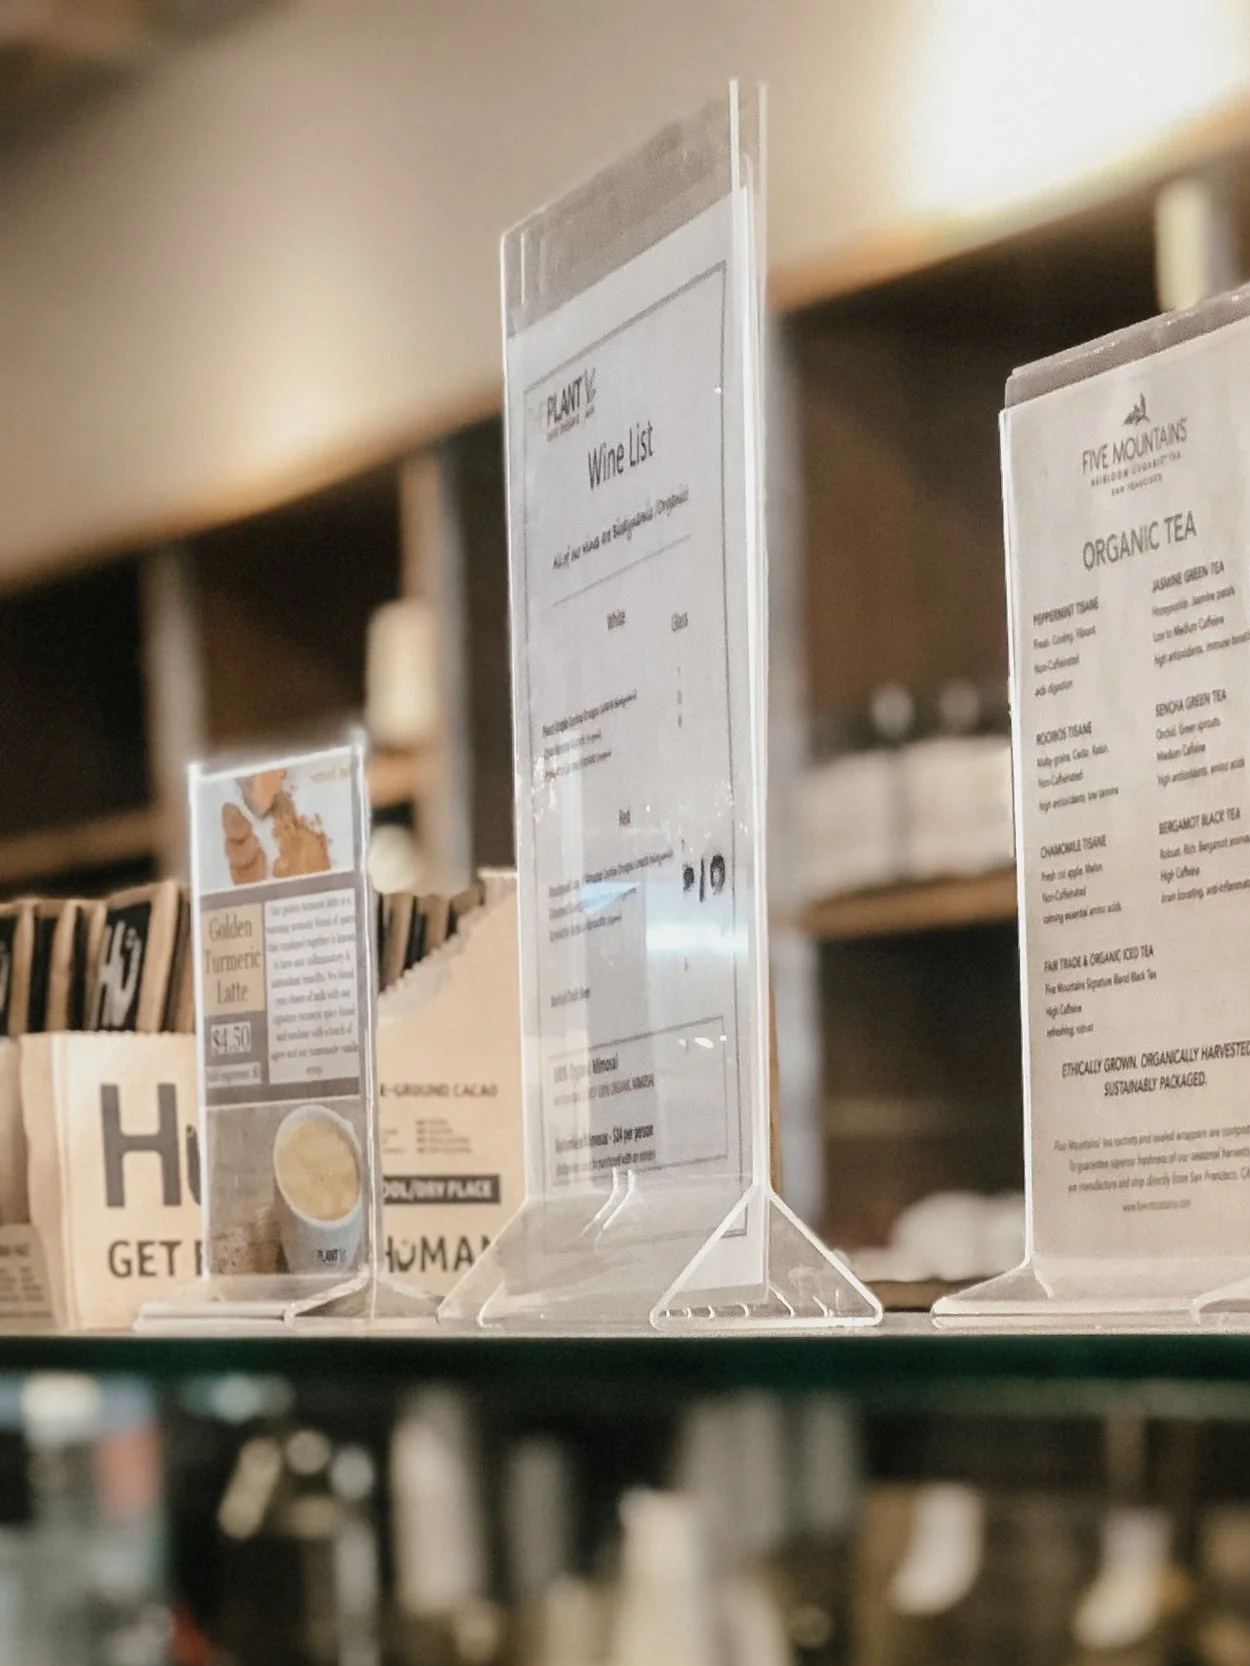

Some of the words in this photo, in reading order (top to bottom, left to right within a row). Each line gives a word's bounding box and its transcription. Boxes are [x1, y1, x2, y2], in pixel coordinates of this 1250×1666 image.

[547, 376, 583, 427] PLANT
[588, 442, 624, 490] Wine
[629, 420, 653, 467] List
[1082, 444, 1109, 475] FIVE
[1112, 419, 1187, 465] MOUNTAINS
[1082, 521, 1160, 570] ORGANIC
[1164, 510, 1197, 545] TEA
[1152, 571, 1183, 593] JASMINE
[1184, 564, 1208, 583] GREEN
[1210, 560, 1225, 576] TEA
[1033, 603, 1075, 625] PEPPERMINT
[1076, 596, 1099, 614] TISANE
[1155, 699, 1184, 718] SENCHA
[1185, 692, 1211, 710] GREEN
[1212, 688, 1227, 704] TEA
[1036, 727, 1066, 745] ROOIBOS
[1068, 720, 1092, 738] TISANE
[1159, 814, 1200, 835] BERGAMOT
[1201, 808, 1225, 827] BLACK
[1226, 807, 1241, 821] TEA
[1040, 839, 1082, 859] CHAMOMILE
[1082, 833, 1106, 851] TISANE
[209, 912, 253, 942] Golden
[204, 945, 261, 975] Turmeric
[1044, 960, 1058, 972] FAIR
[1060, 955, 1081, 969] TRADE
[1082, 954, 1088, 968] &
[1090, 948, 1121, 966] ORGANIC
[1123, 946, 1140, 961] ICED
[1140, 944, 1154, 958] TEA
[217, 979, 249, 1005] Latte
[1061, 1058, 1102, 1078] ETHICALLY
[1103, 1056, 1137, 1073] GROWN.
[1140, 1047, 1200, 1069] ORGANICALLY
[453, 1083, 499, 1099] CACAO
[1104, 1077, 1158, 1097] SUSTAINABLY
[1159, 1071, 1207, 1090] PACKAGED.
[100, 1083, 201, 1208] H
[108, 1240, 182, 1278] GET
